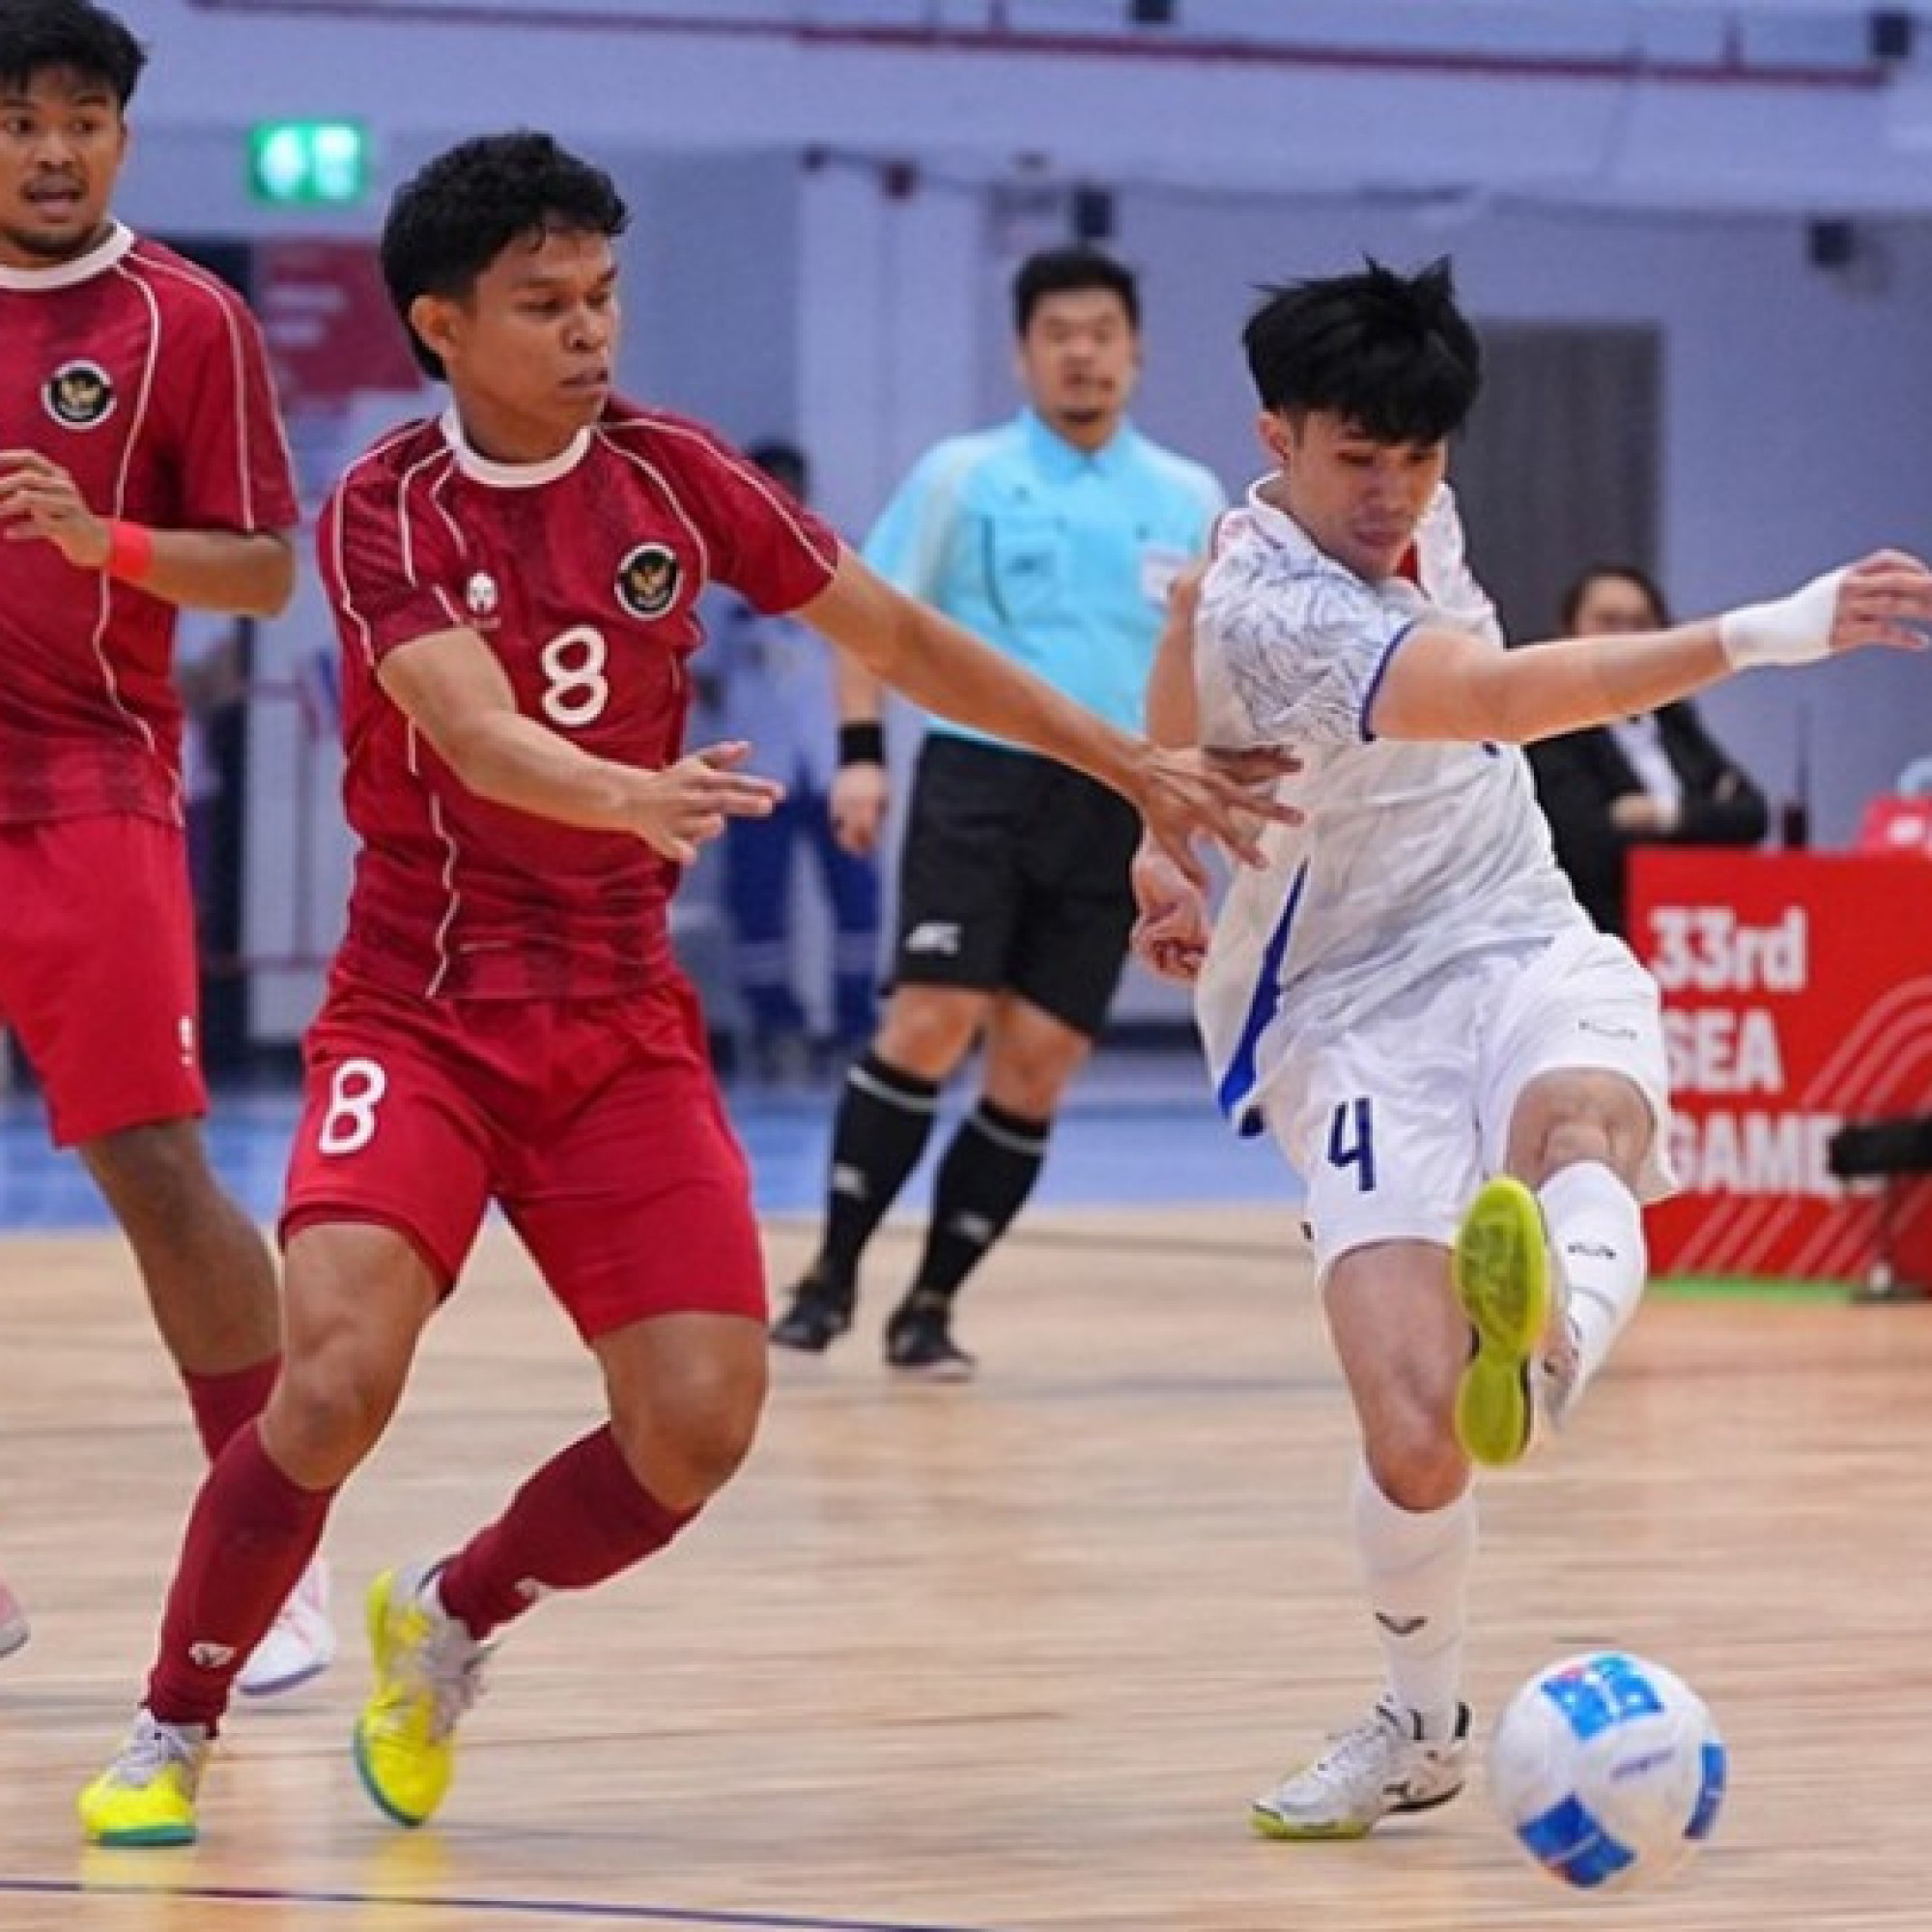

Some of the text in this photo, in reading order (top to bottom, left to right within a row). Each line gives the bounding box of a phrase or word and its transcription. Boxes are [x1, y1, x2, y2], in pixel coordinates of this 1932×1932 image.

[541, 626, 608, 725] 8
[1649, 904, 1809, 993] 33rd
[1662, 1009, 1786, 1094] SEA
[318, 1059, 386, 1153] 8
[1328, 1097, 1376, 1191] 4
[1668, 1111, 1887, 1198] GAME
